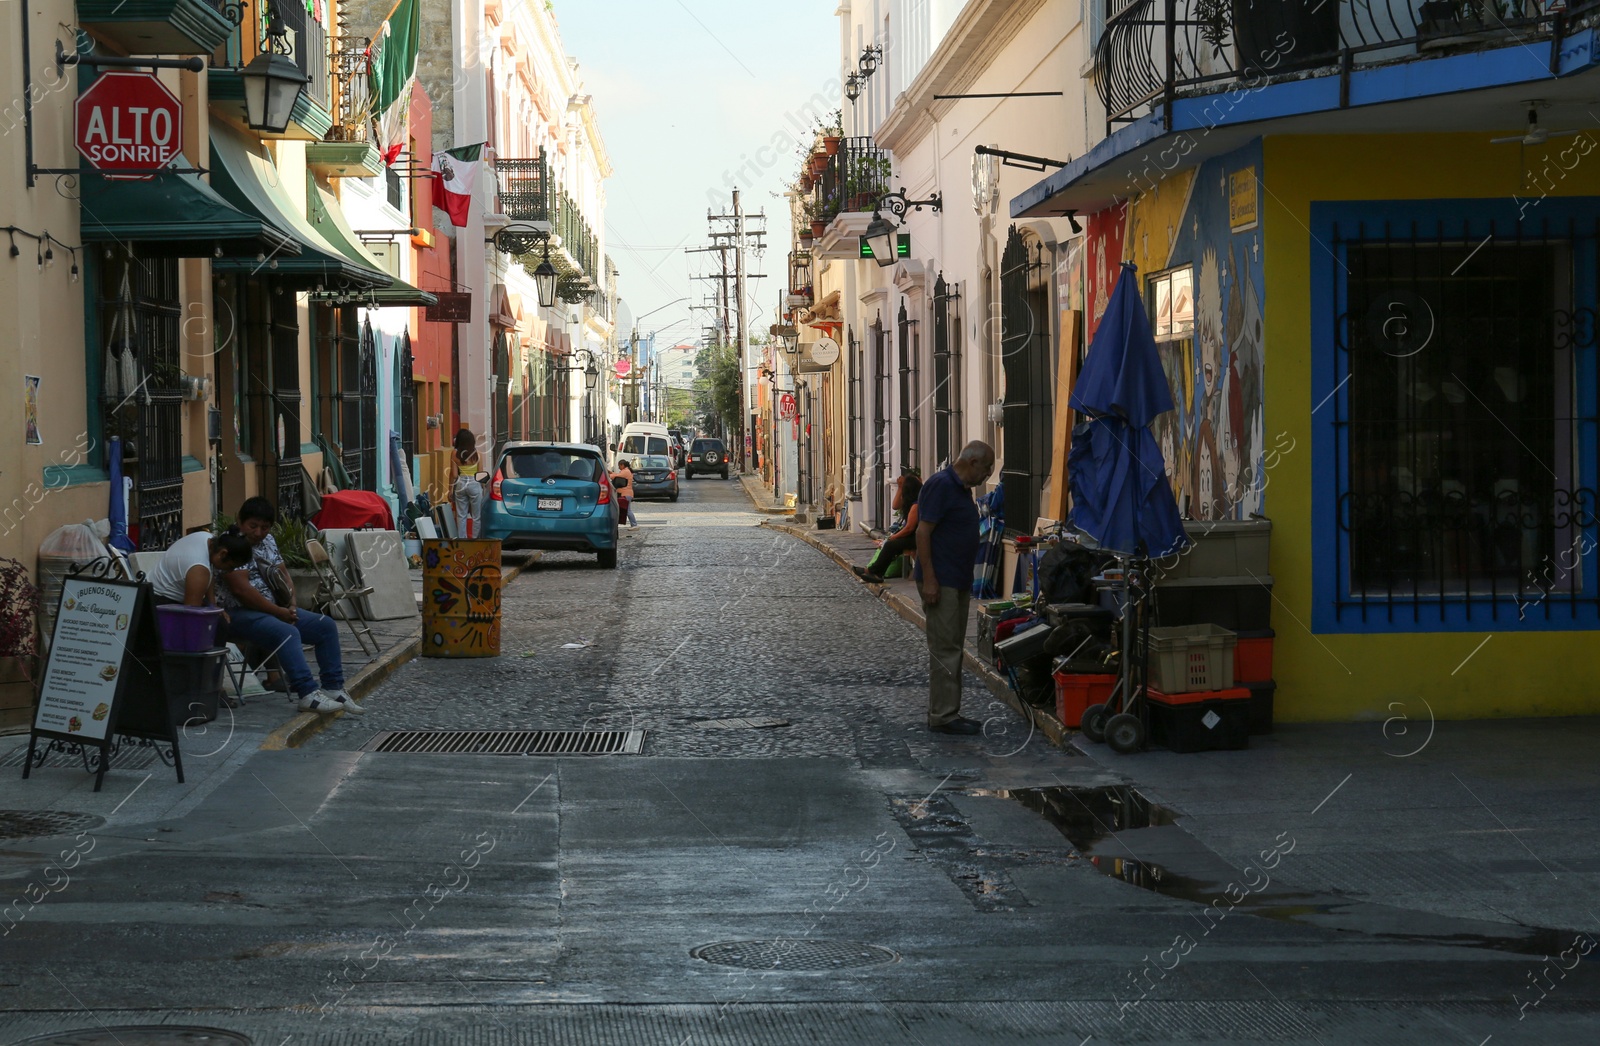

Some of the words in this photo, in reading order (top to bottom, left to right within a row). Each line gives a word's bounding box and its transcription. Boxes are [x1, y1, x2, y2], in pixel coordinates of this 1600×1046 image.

[85, 105, 172, 146] ALTO
[90, 144, 170, 163] SONRIE
[77, 586, 105, 599] ¡BUENOS
[106, 588, 122, 603] DÍAS!
[90, 603, 117, 618] Desayunos
